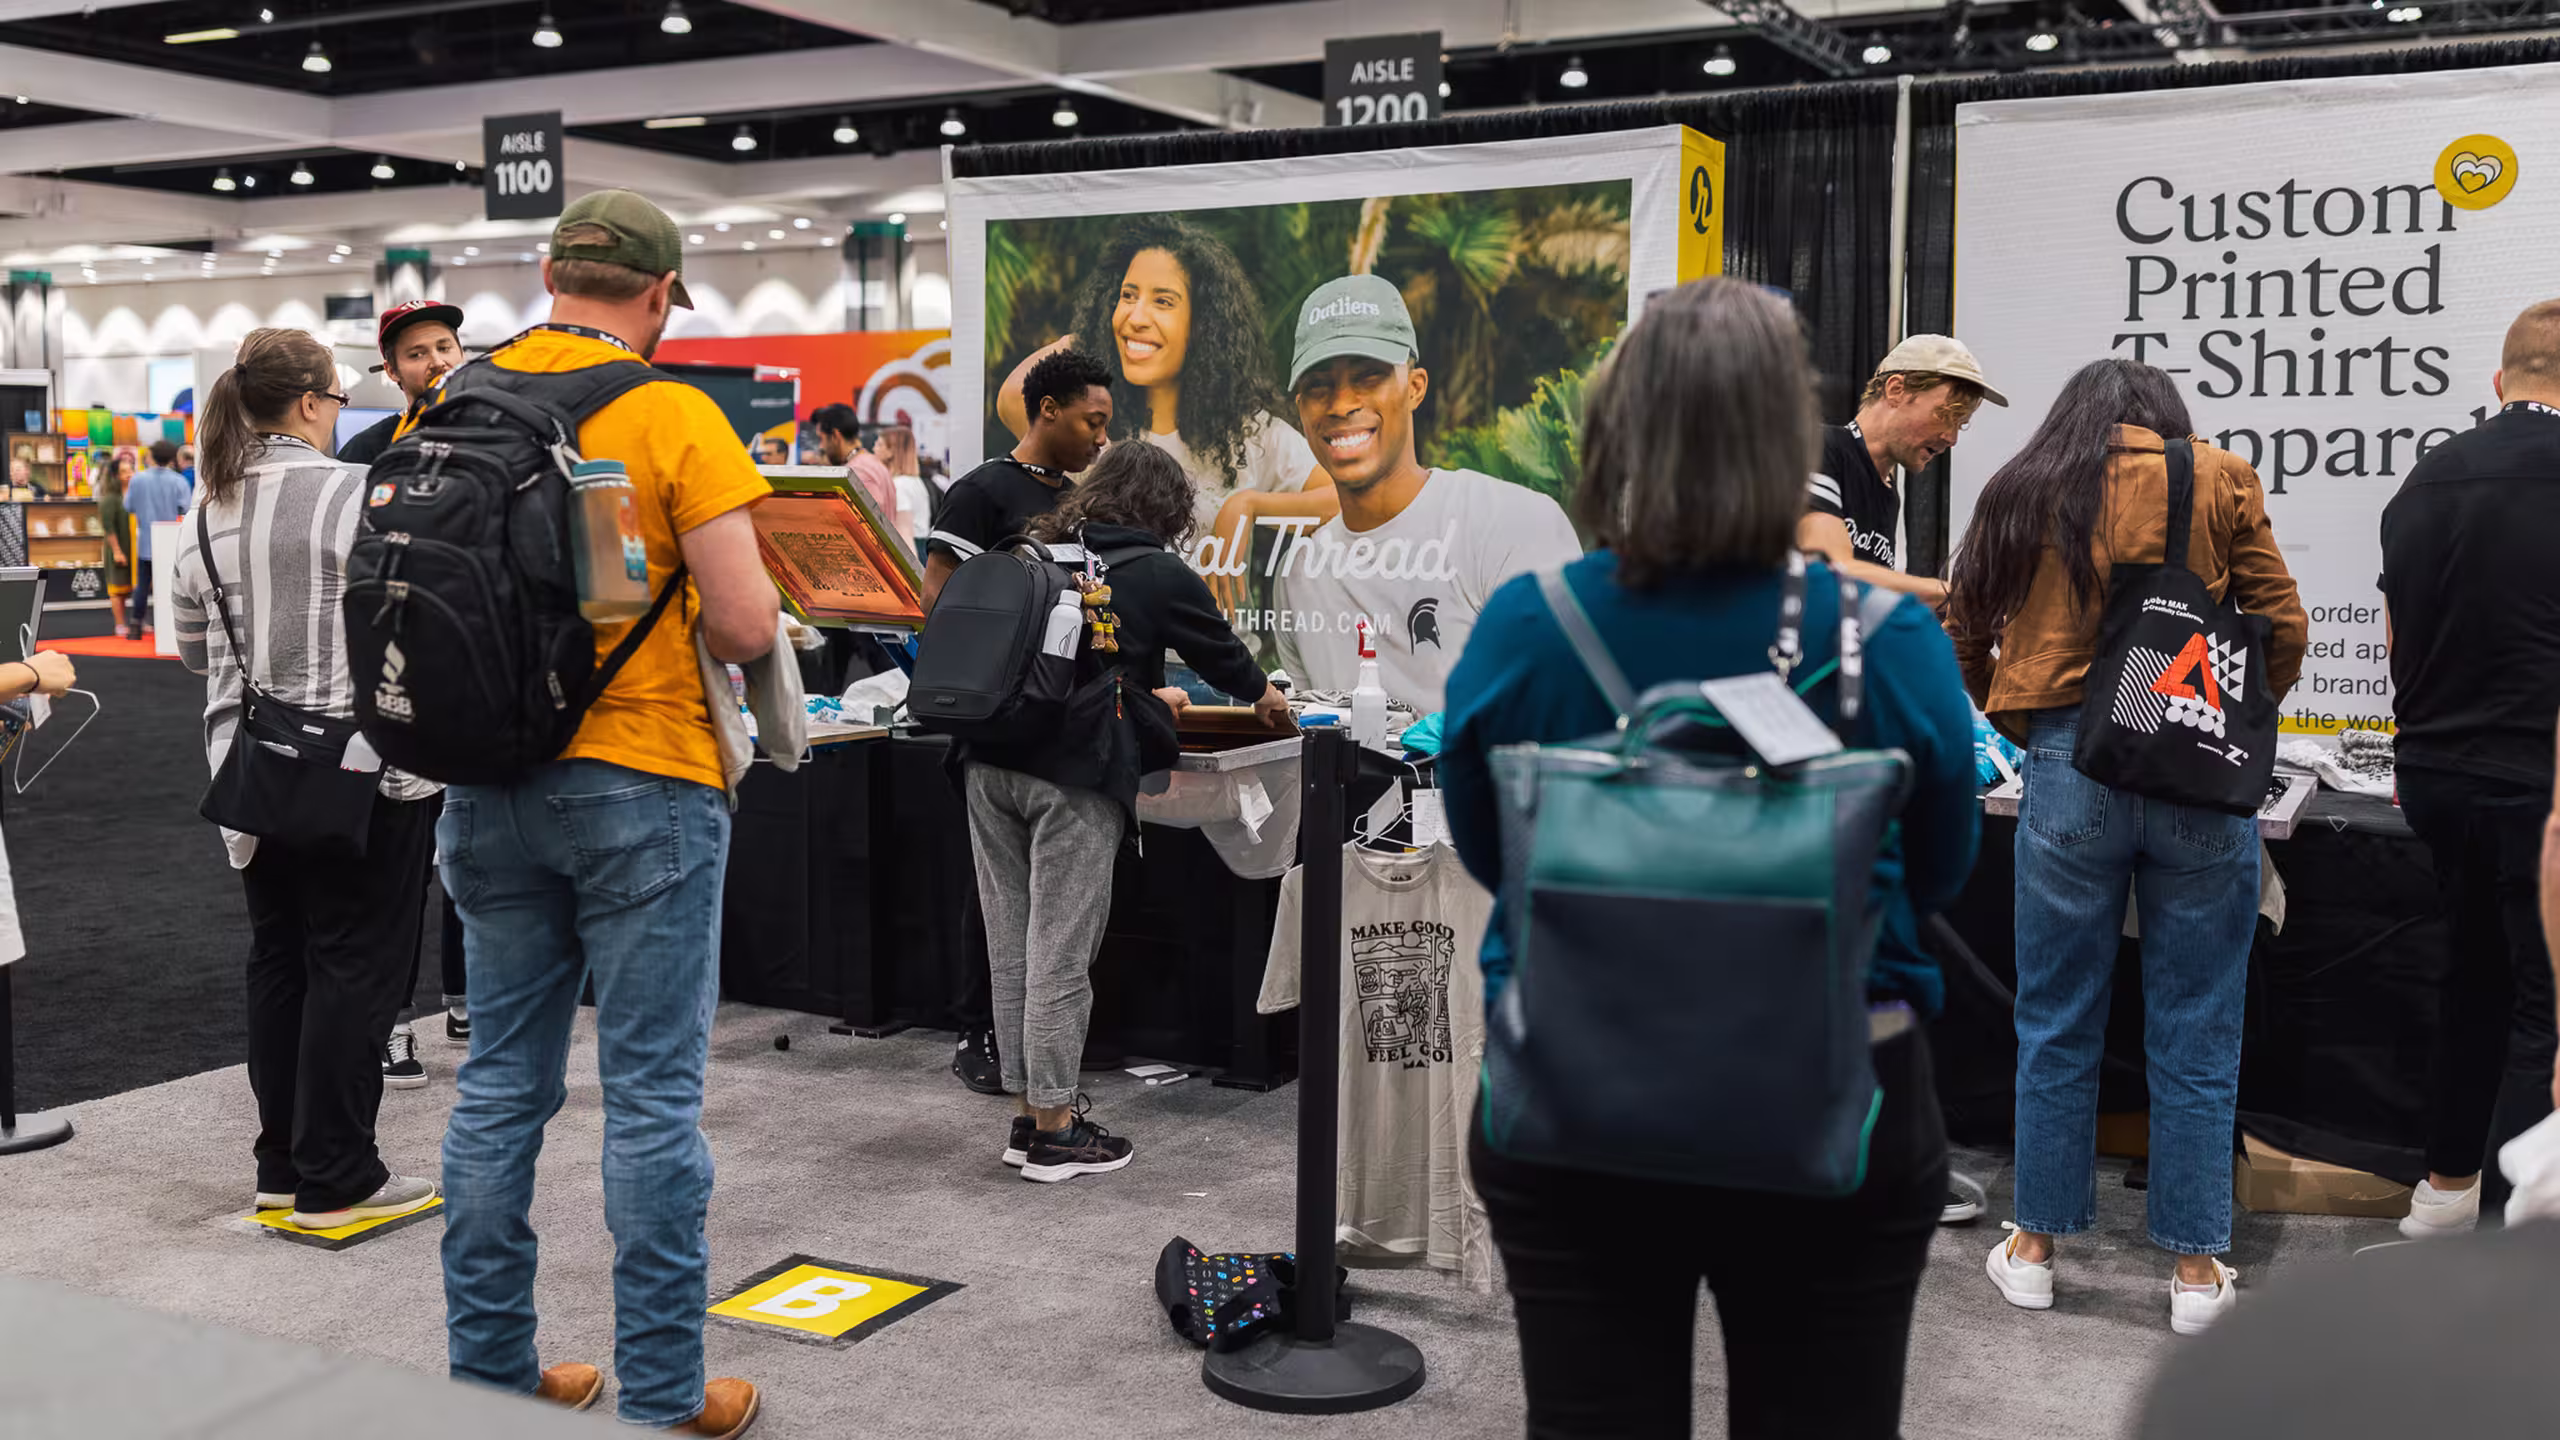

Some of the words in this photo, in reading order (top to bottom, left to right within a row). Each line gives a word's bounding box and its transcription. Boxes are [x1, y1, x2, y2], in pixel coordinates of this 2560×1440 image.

[1350, 57, 1414, 84] AISLE
[1336, 92, 1428, 127] 1200
[500, 130, 546, 154] AISLE
[494, 159, 554, 196] 1100
[2116, 176, 2457, 245] Custom
[2124, 244, 2445, 321] Printed
[1308, 296, 1380, 325] Outliers
[2112, 327, 2450, 399] T-Shirts
[2215, 406, 2486, 494] ppare
[1185, 514, 1247, 577] al
[1255, 516, 1456, 581] Thread
[2167, 599, 2188, 611] MAX
[2311, 603, 2380, 624] order
[2305, 638, 2345, 658] ted
[2313, 673, 2387, 695] brand
[2294, 707, 2335, 729] the
[1350, 921, 1405, 941] MAKE
[1368, 1046, 1411, 1062] FEEL
[1420, 1044, 1453, 1063] GO
[747, 1276, 872, 1319] B
